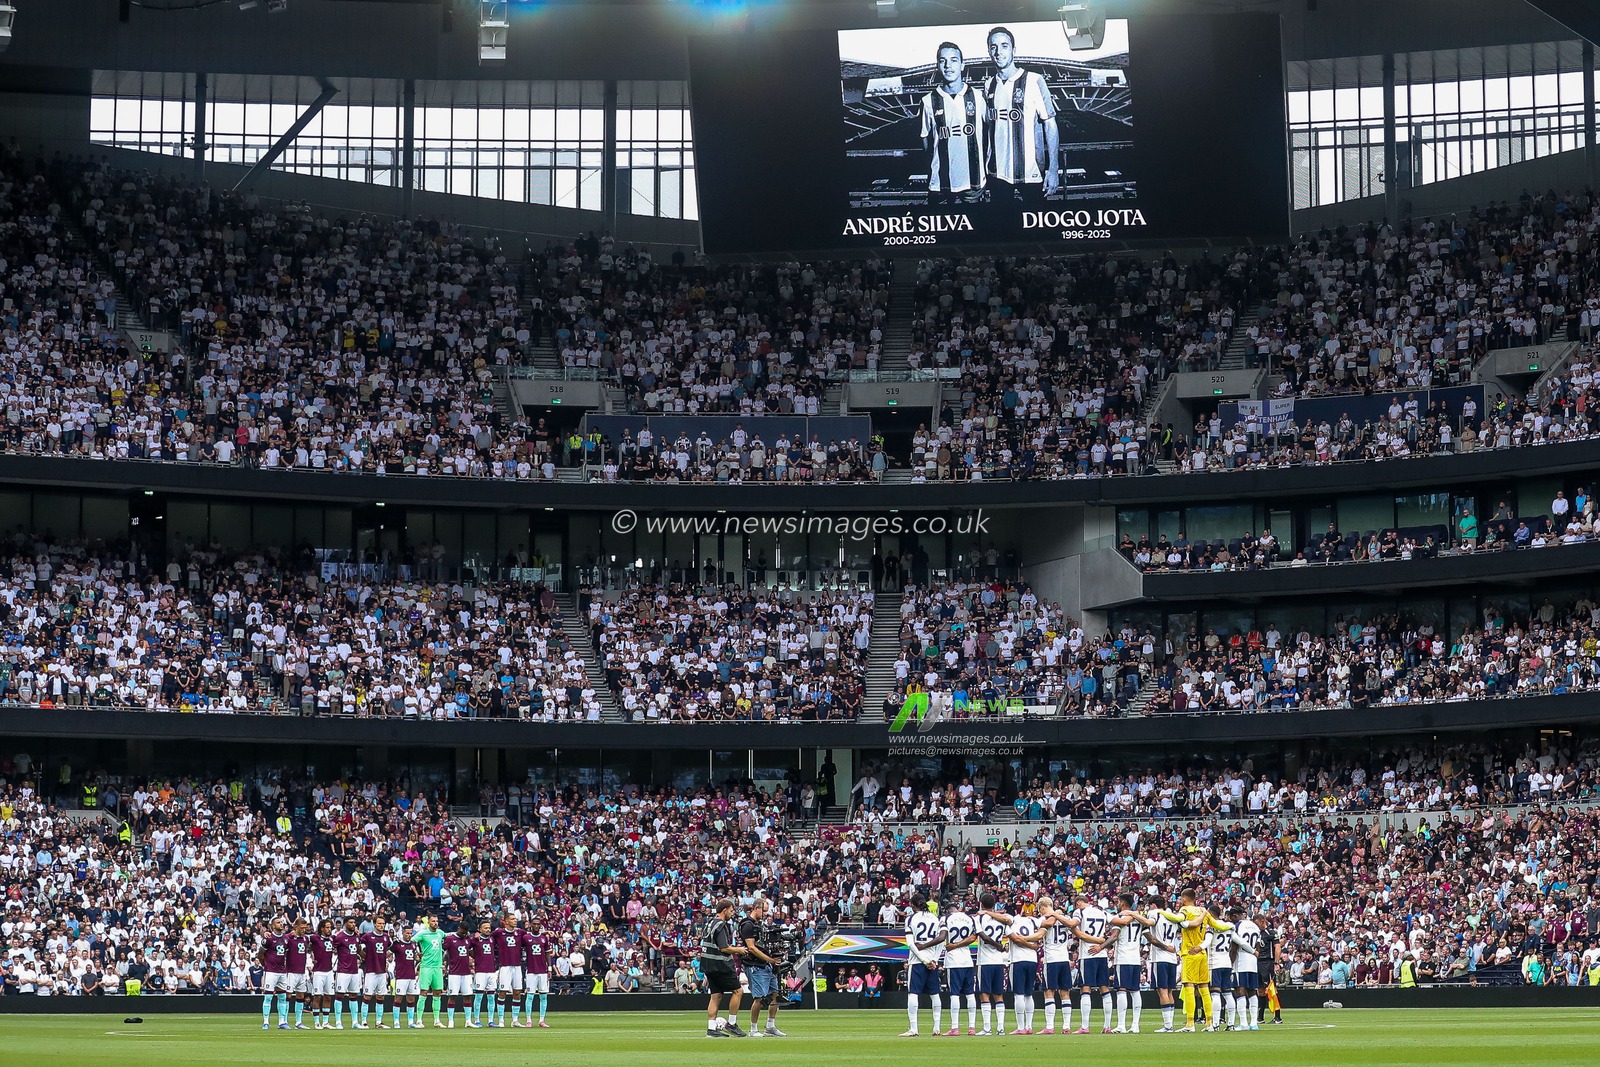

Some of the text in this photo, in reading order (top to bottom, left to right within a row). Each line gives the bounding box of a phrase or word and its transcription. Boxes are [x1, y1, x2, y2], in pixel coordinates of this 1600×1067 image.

[842, 211, 974, 236] ANDRÉ SILVA
[1022, 209, 1147, 229] DIOGO JOTA
[883, 235, 936, 246] 2000-2025
[1061, 229, 1111, 239] 1996-2025
[139, 334, 153, 342] 517
[72, 816, 82, 824] 11
[1437, 814, 1446, 822] 11
[985, 828, 1001, 836] 116
[916, 922, 937, 941] 24
[949, 926, 970, 944] 29
[984, 925, 1004, 945] 22
[1052, 925, 1067, 944] 15
[1085, 917, 1106, 938] 37
[1127, 923, 1141, 942] 17
[1163, 923, 1175, 942] 14
